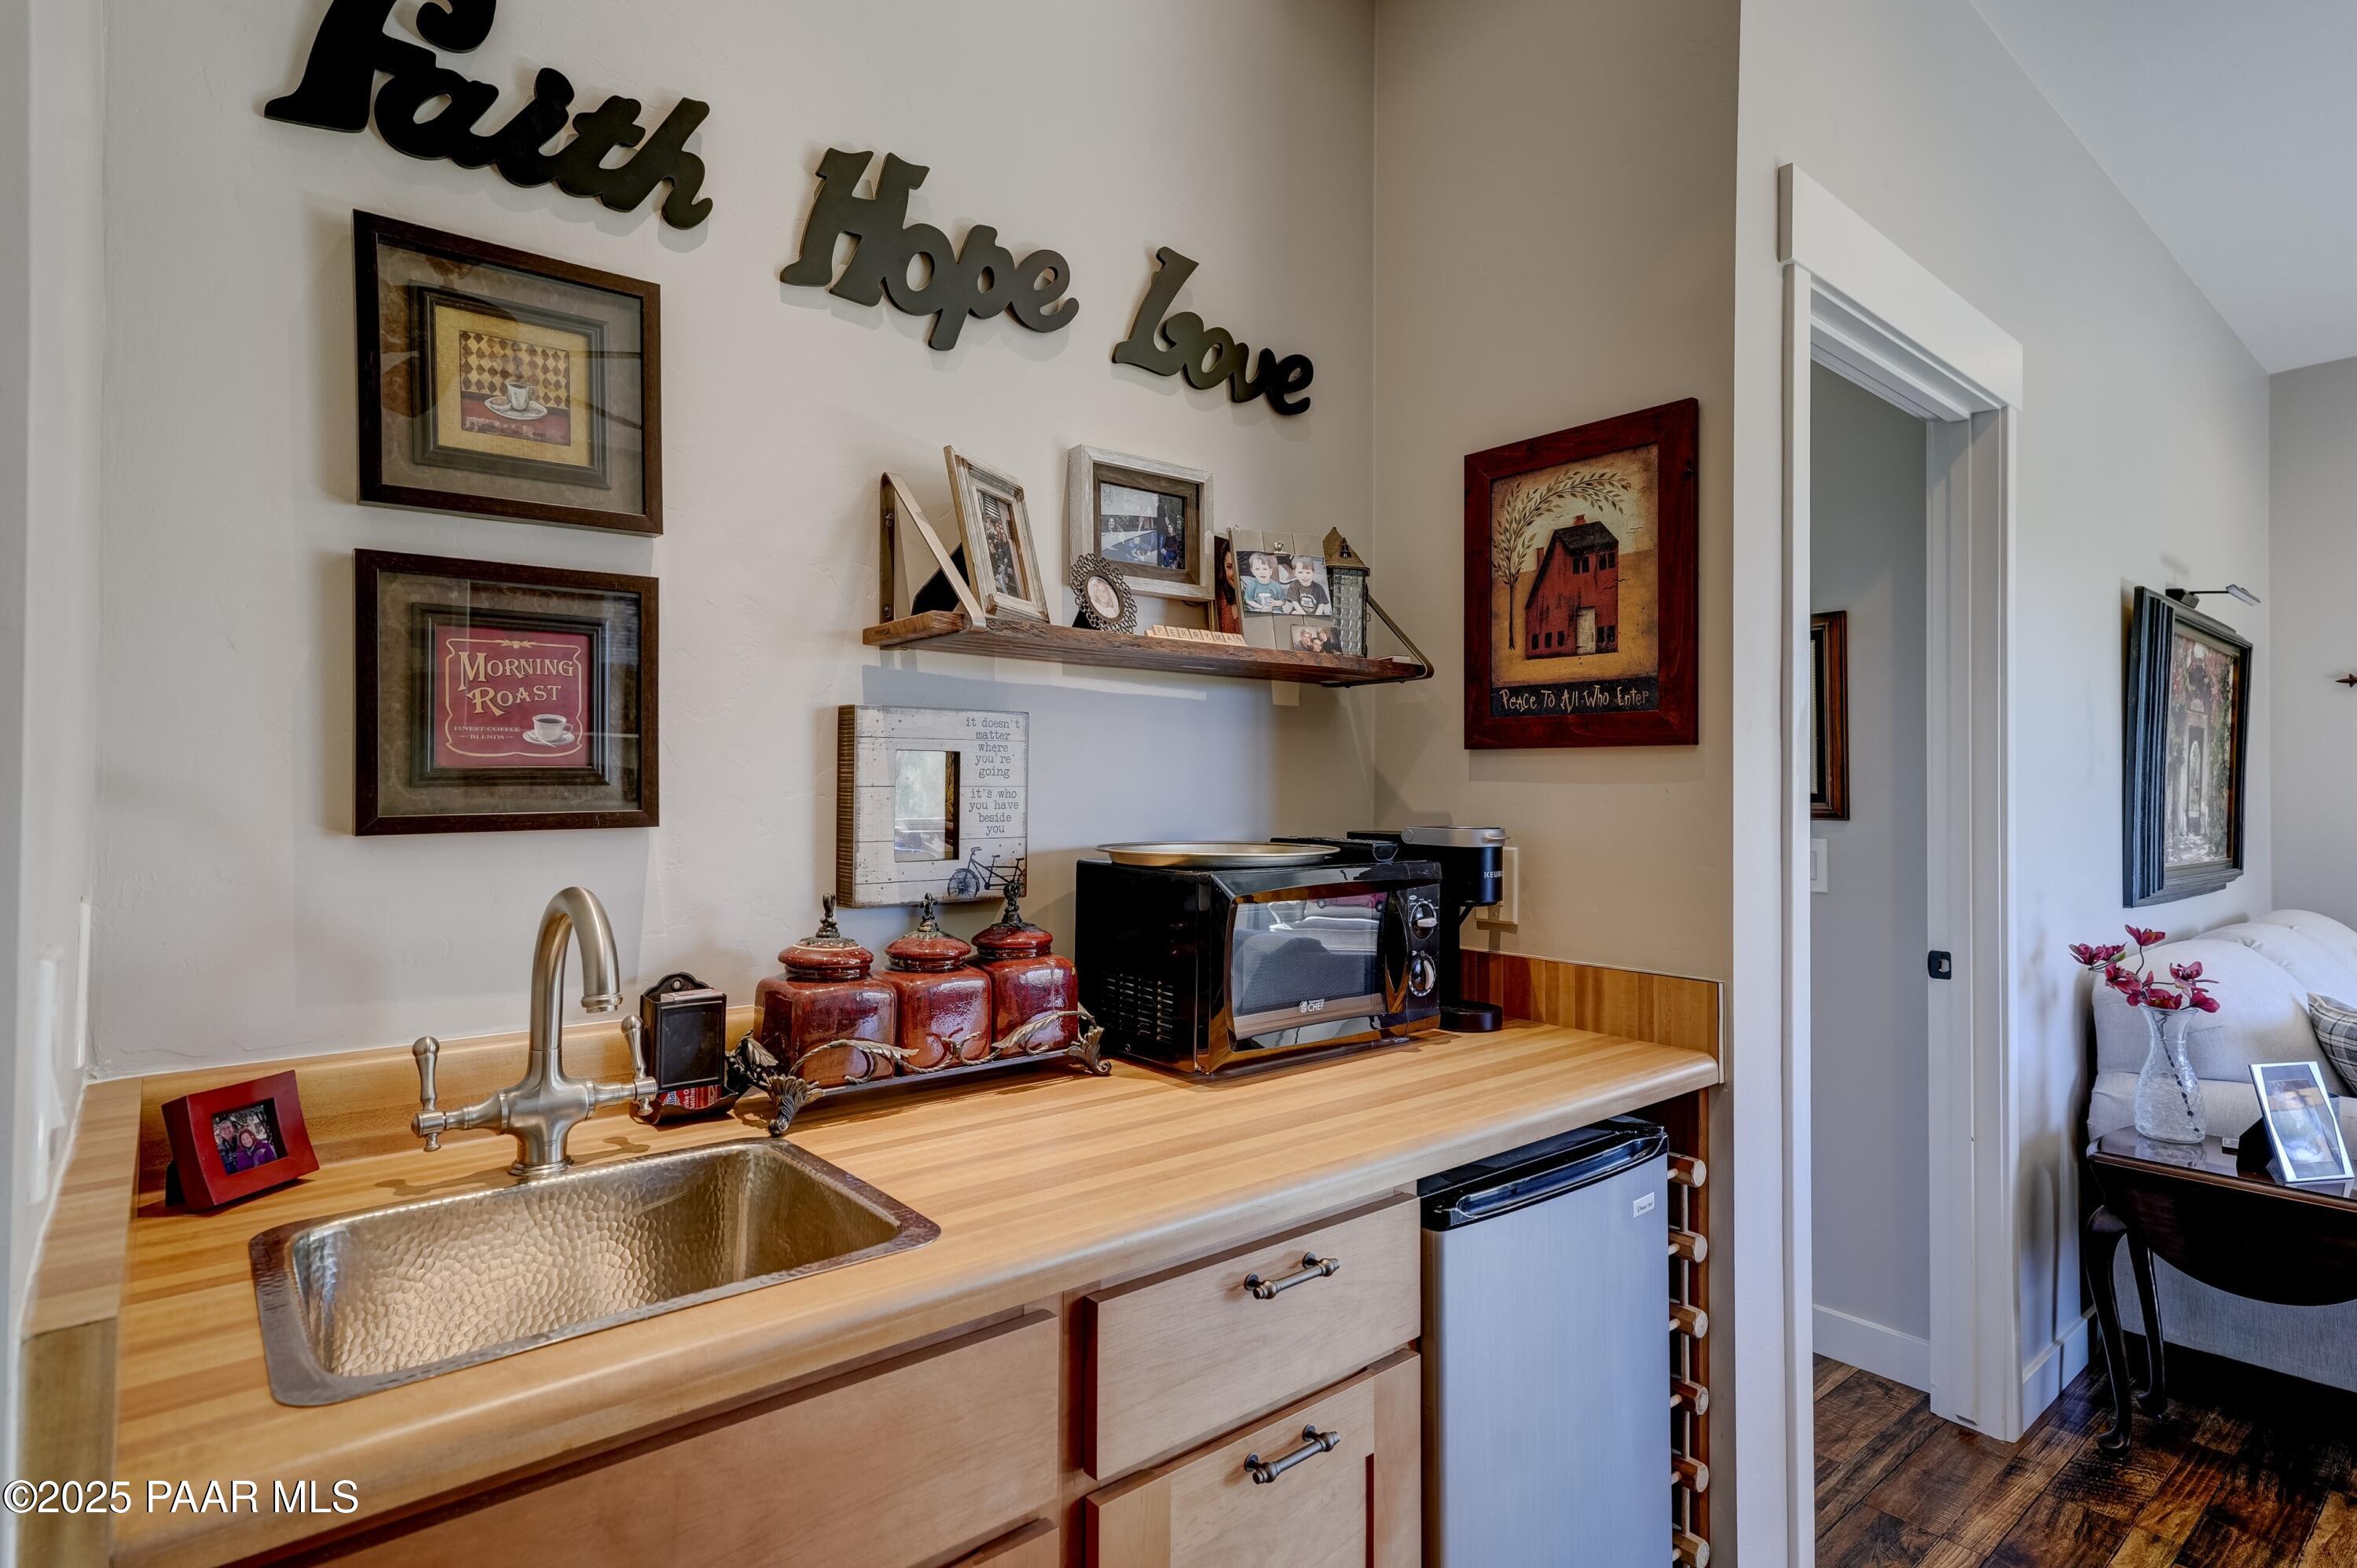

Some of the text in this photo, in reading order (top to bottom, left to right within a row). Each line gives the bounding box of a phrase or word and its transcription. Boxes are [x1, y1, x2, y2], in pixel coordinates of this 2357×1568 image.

[264, 0, 713, 229] Faith
[779, 147, 1080, 351] Hope
[1112, 247, 1314, 416] Love
[457, 651, 575, 691] MORNING
[466, 685, 563, 716] ROAST
[1541, 690, 1556, 708] To
[1560, 688, 1578, 713] All
[1583, 685, 1610, 708] Who
[1617, 686, 1649, 707] Enter
[965, 716, 1021, 729] it doesn't
[976, 730, 1011, 740] matter
[977, 742, 1009, 753] where
[974, 753, 1012, 766] you're
[978, 766, 1010, 779] going
[970, 788, 1017, 799] it's who
[968, 800, 1019, 813] you have
[978, 811, 1012, 822] beside
[985, 825, 1006, 837] you
[1307, 1002, 1325, 1012] CHEF
